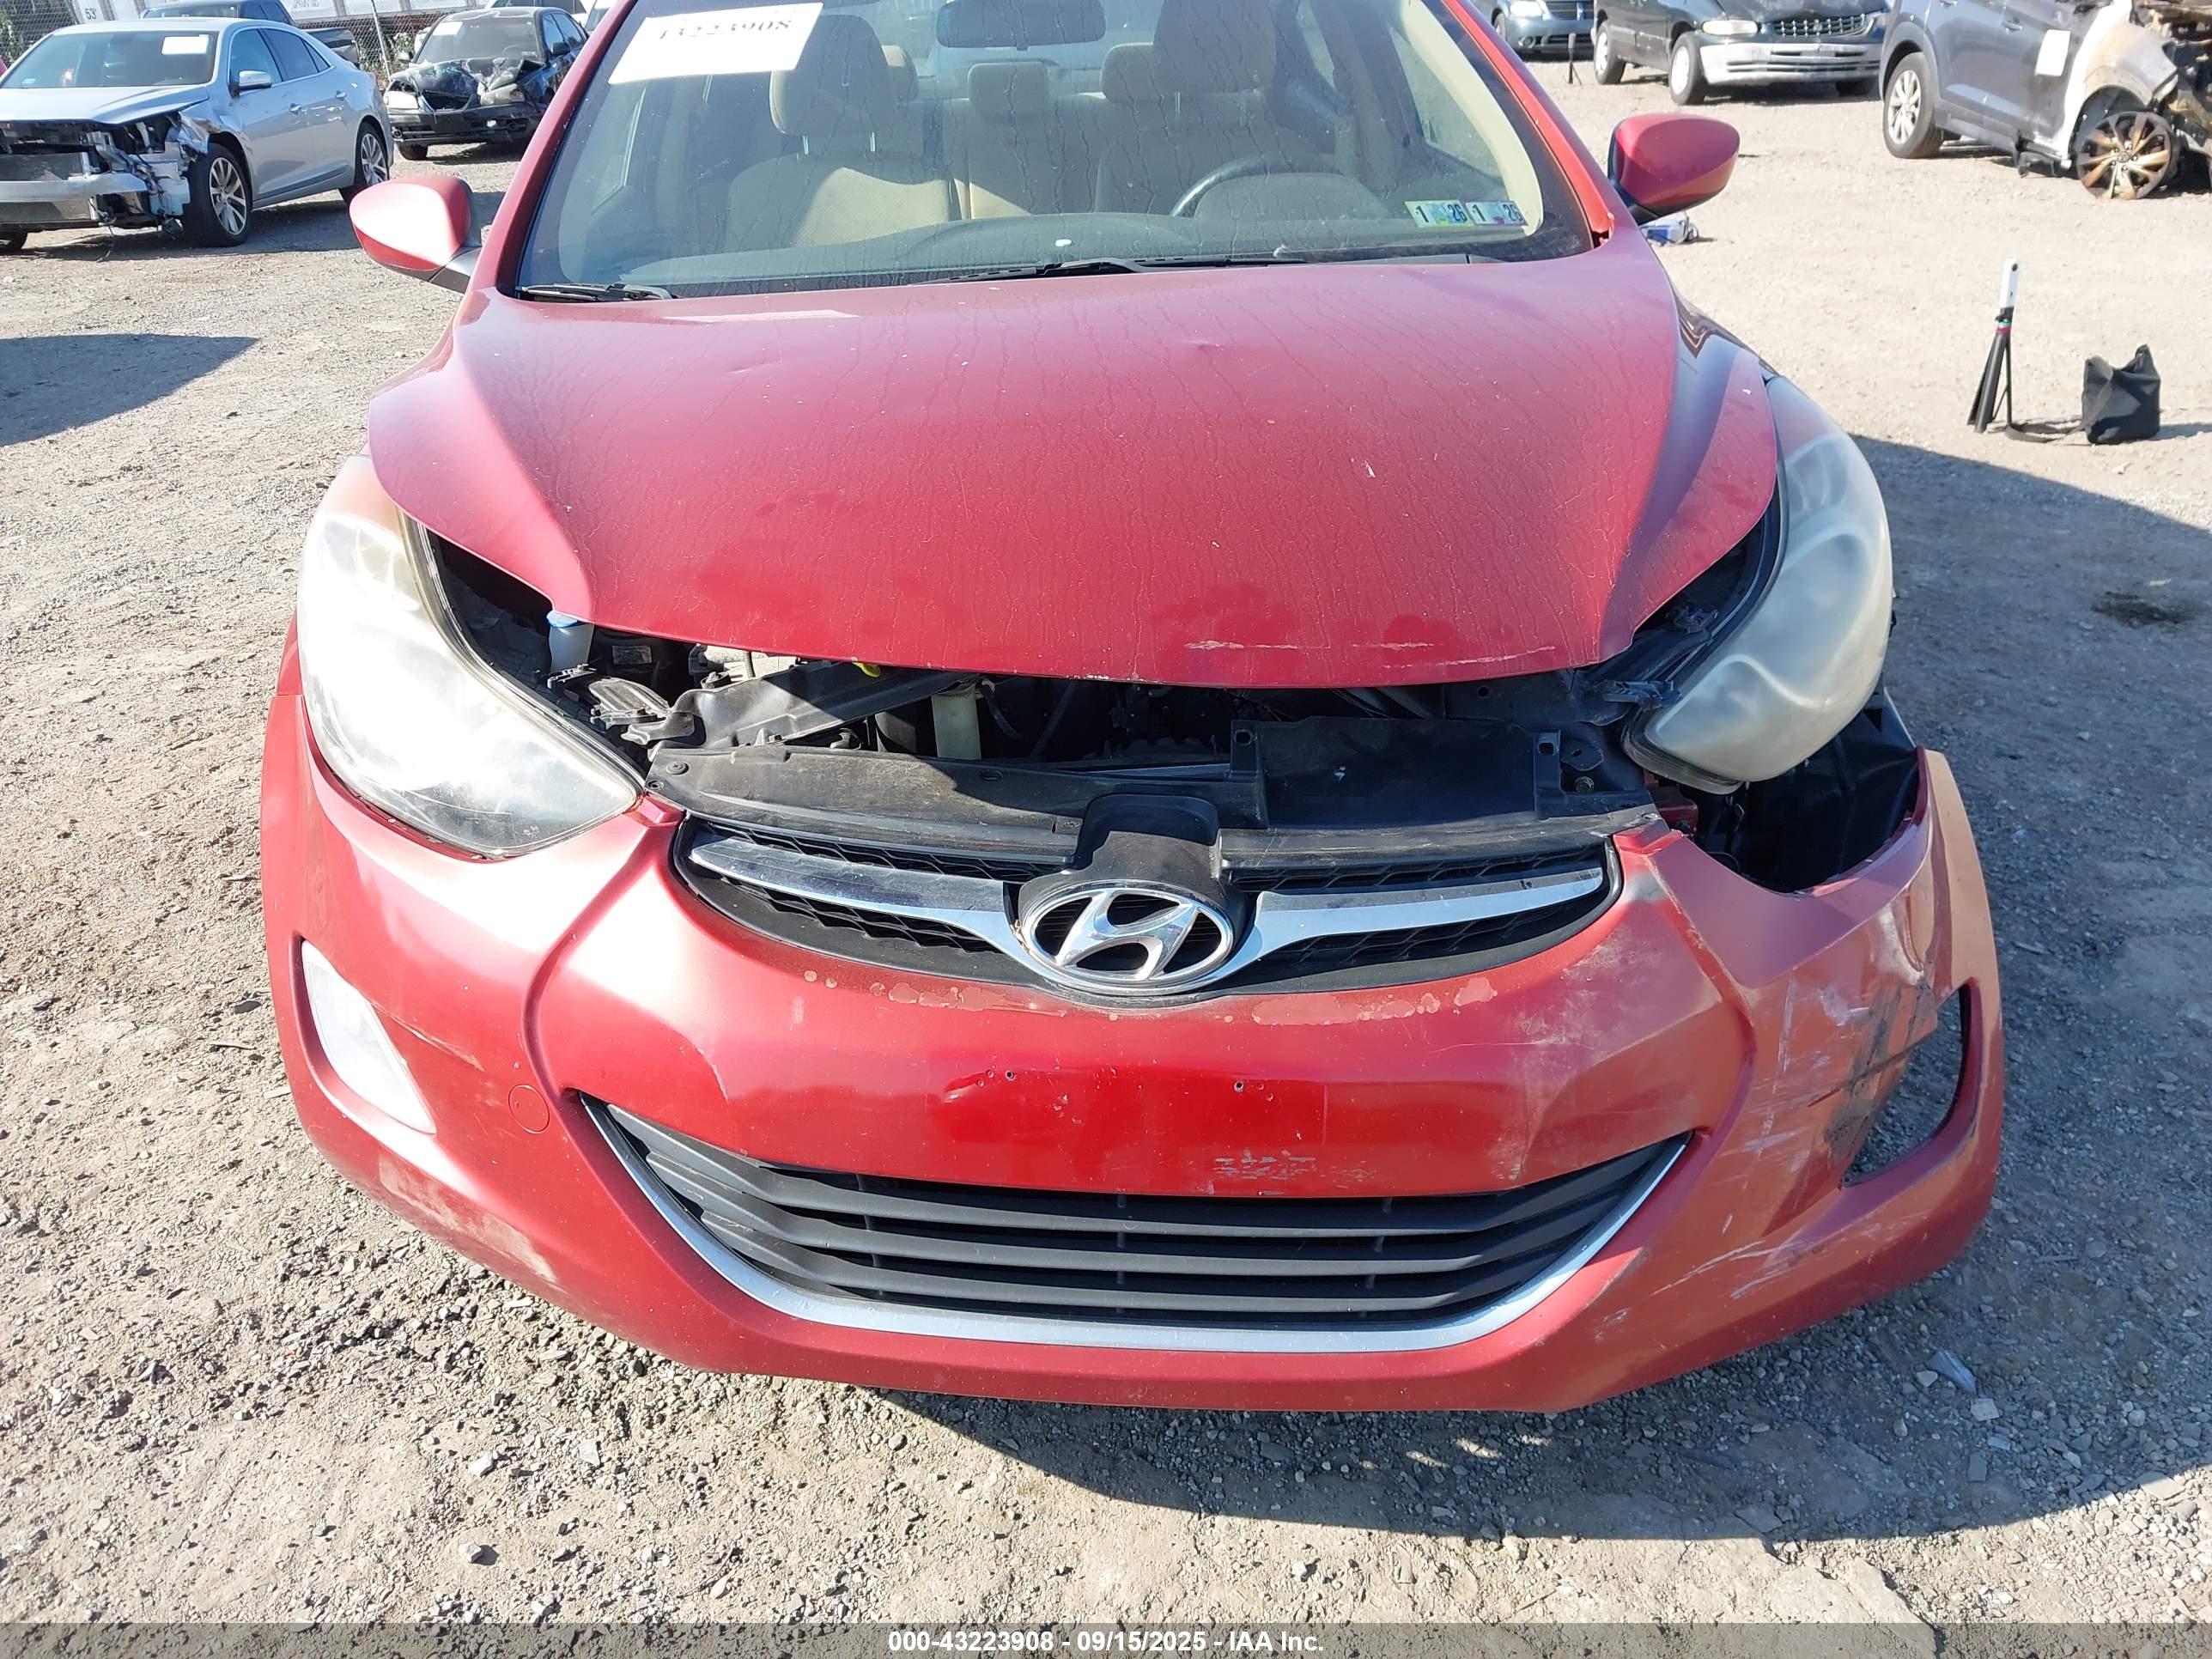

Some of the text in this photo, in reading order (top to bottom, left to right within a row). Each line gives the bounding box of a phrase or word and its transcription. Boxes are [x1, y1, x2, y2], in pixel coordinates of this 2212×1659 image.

[1415, 204, 1468, 223] 1 26
[1472, 204, 1486, 222] 1
